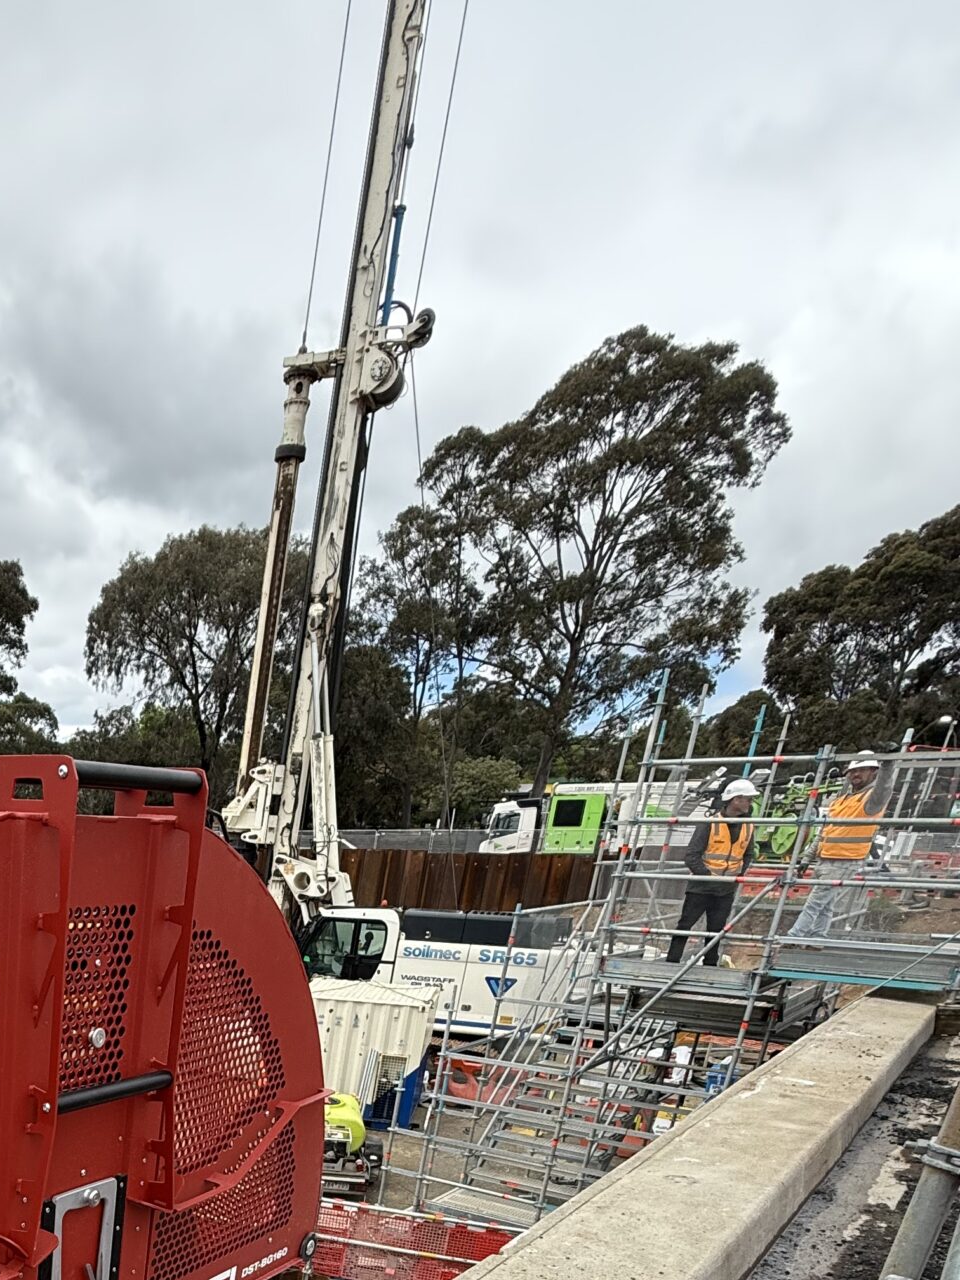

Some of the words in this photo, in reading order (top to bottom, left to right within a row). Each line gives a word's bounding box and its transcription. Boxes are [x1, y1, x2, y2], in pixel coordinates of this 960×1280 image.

[403, 944, 462, 961] soilmec
[478, 949, 538, 966] SR65
[401, 974, 455, 983] WAGSTAFF
[241, 1246, 288, 1278] DST-BG160
